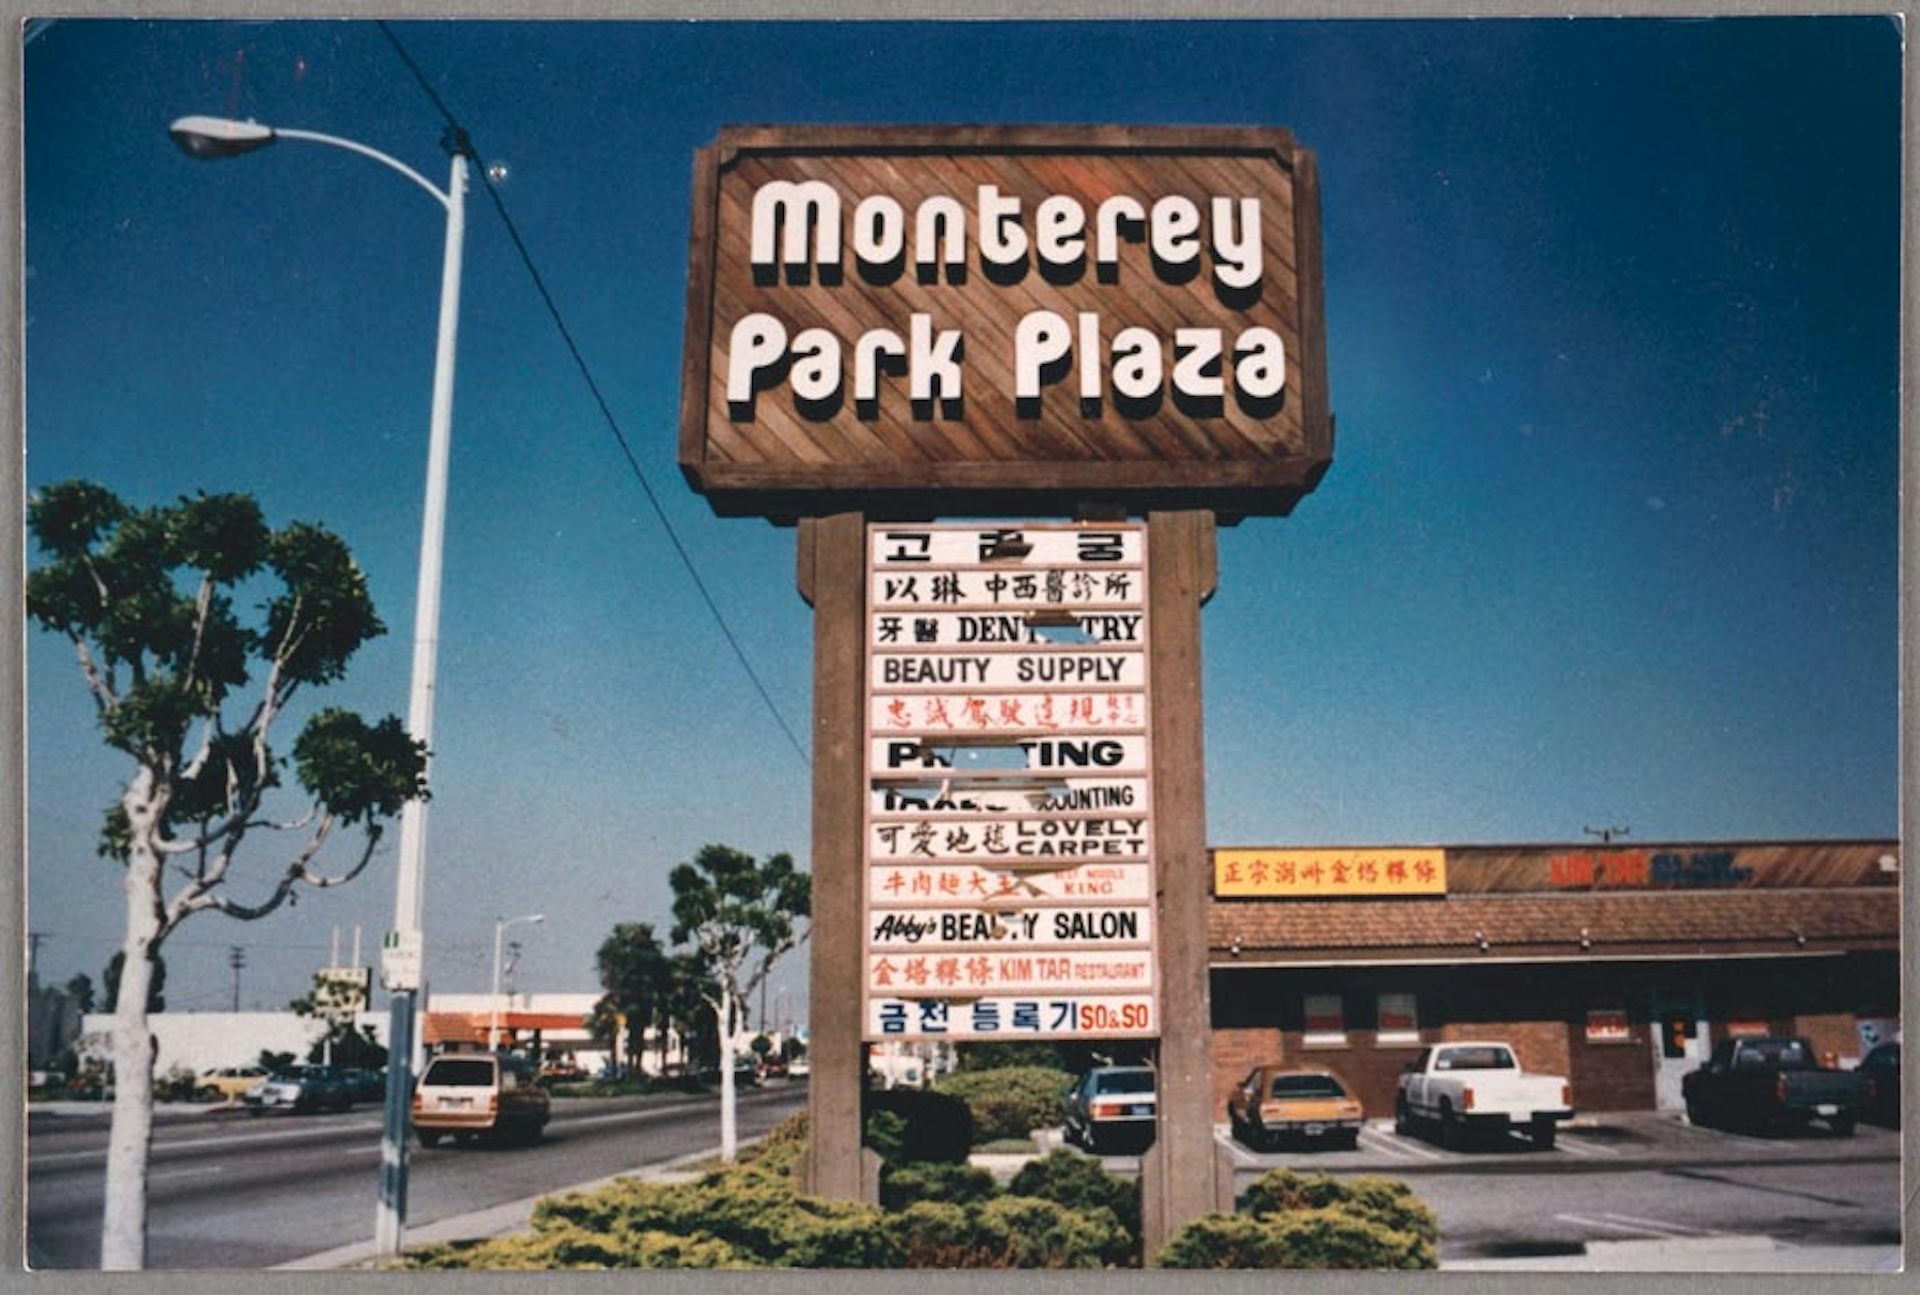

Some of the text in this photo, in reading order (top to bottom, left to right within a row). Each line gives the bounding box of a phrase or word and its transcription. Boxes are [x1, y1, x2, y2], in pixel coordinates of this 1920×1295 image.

[751, 180, 1263, 288] Monterey
[727, 310, 1285, 400] Park Plaza
[884, 657, 1126, 683] BEAUTY SUPPLY
[877, 820, 1010, 857] 可愛地毯
[1017, 820, 1145, 836] LOVELY
[1016, 840, 1144, 856] CARPET
[1064, 882, 1112, 895] KING
[873, 914, 937, 943] Abby's
[1054, 910, 1137, 939] SALON
[999, 959, 1032, 981] KIM
[1037, 957, 1072, 979] TAR
[1074, 962, 1146, 980] RESTAURANT
[879, 1000, 949, 1034] 금전
[972, 1001, 1078, 1032] 등록기
